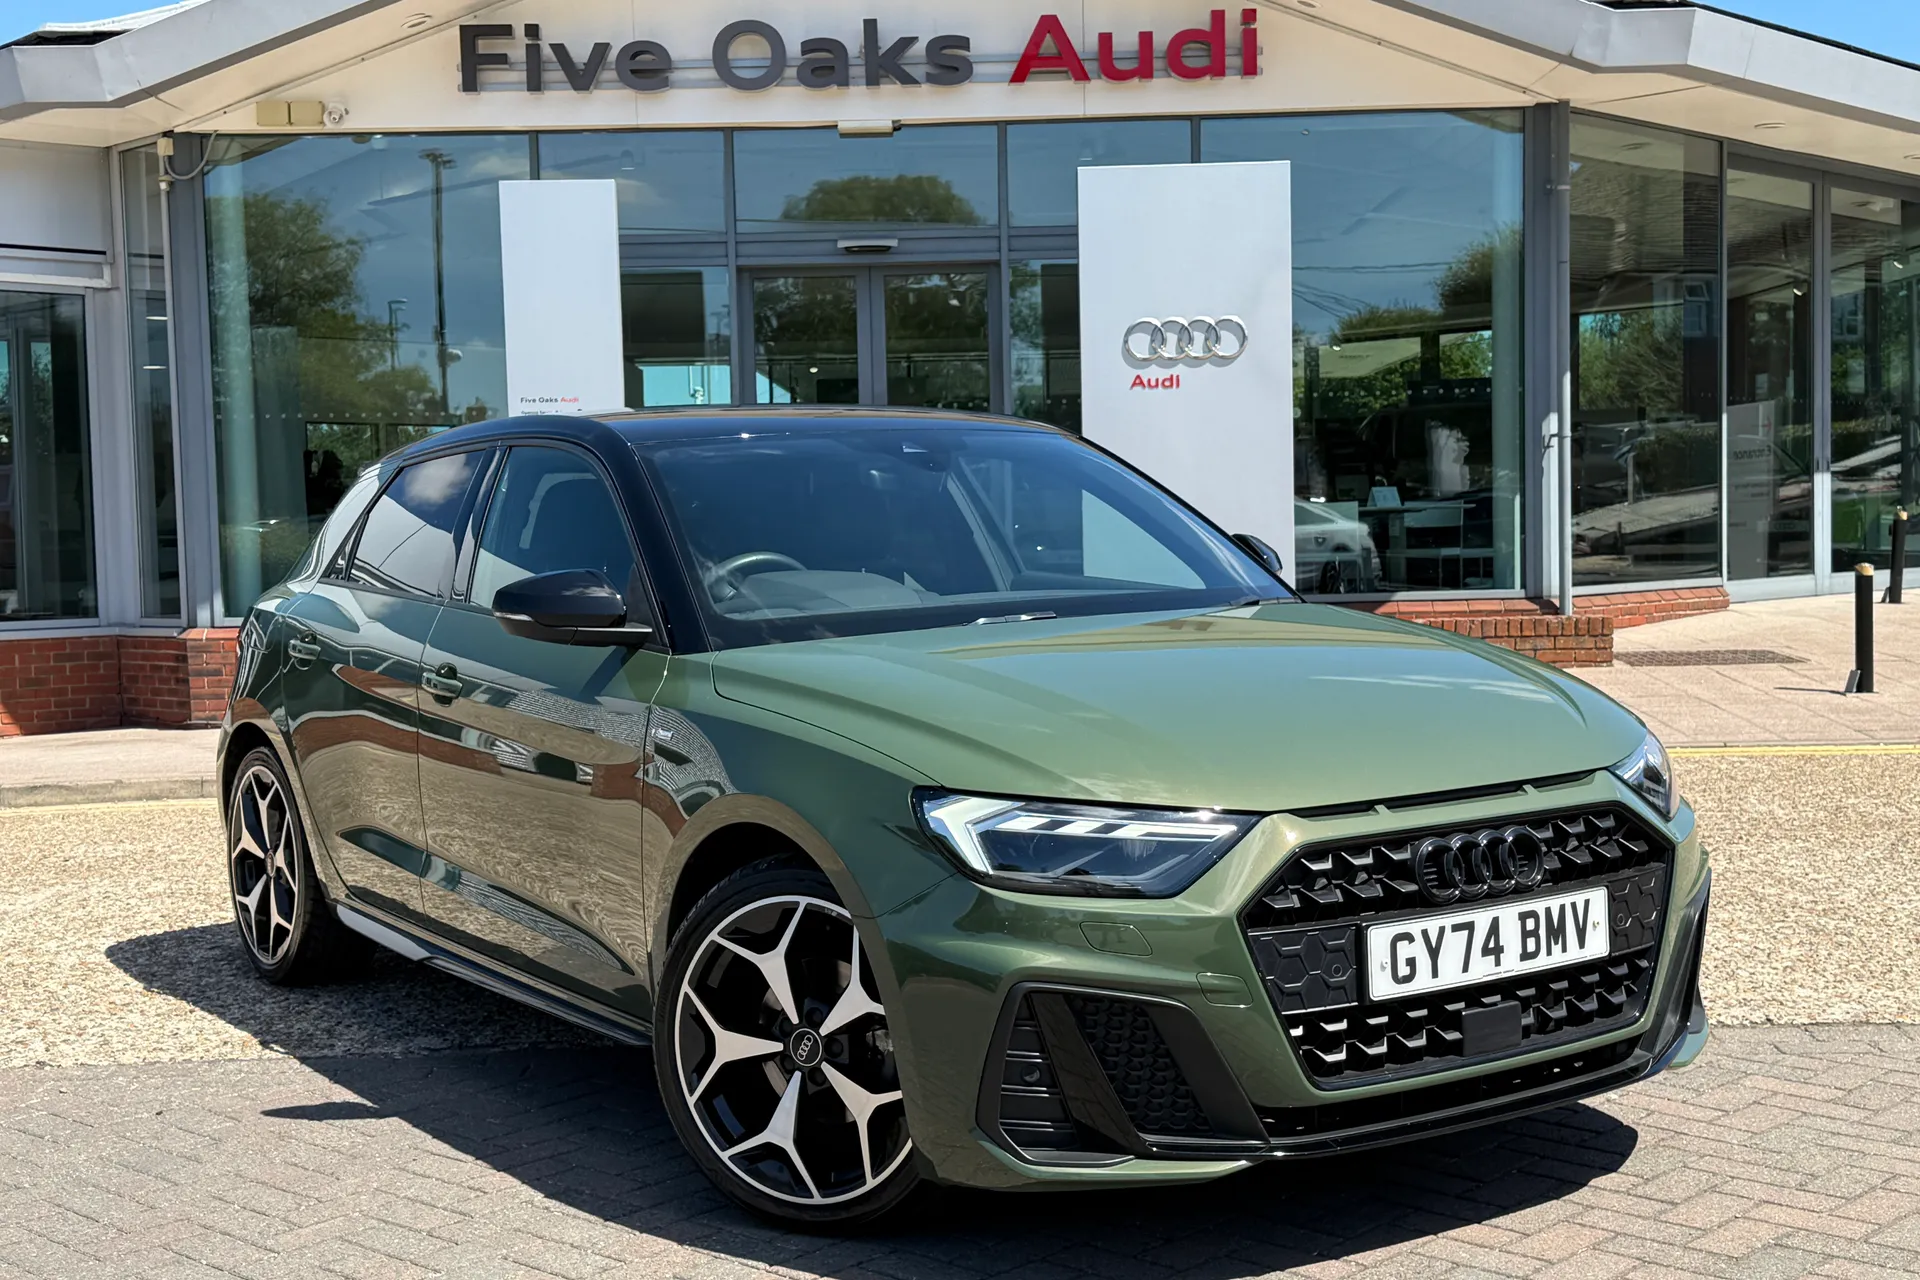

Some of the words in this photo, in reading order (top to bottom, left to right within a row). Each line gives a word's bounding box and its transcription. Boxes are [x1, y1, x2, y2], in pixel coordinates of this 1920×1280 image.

[458, 24, 672, 93] Five
[711, 18, 973, 90] Oaks
[1008, 8, 1259, 84] Audi
[1130, 374, 1180, 389] Audi
[1390, 916, 1504, 985] GY74
[1518, 898, 1590, 961] BMV
